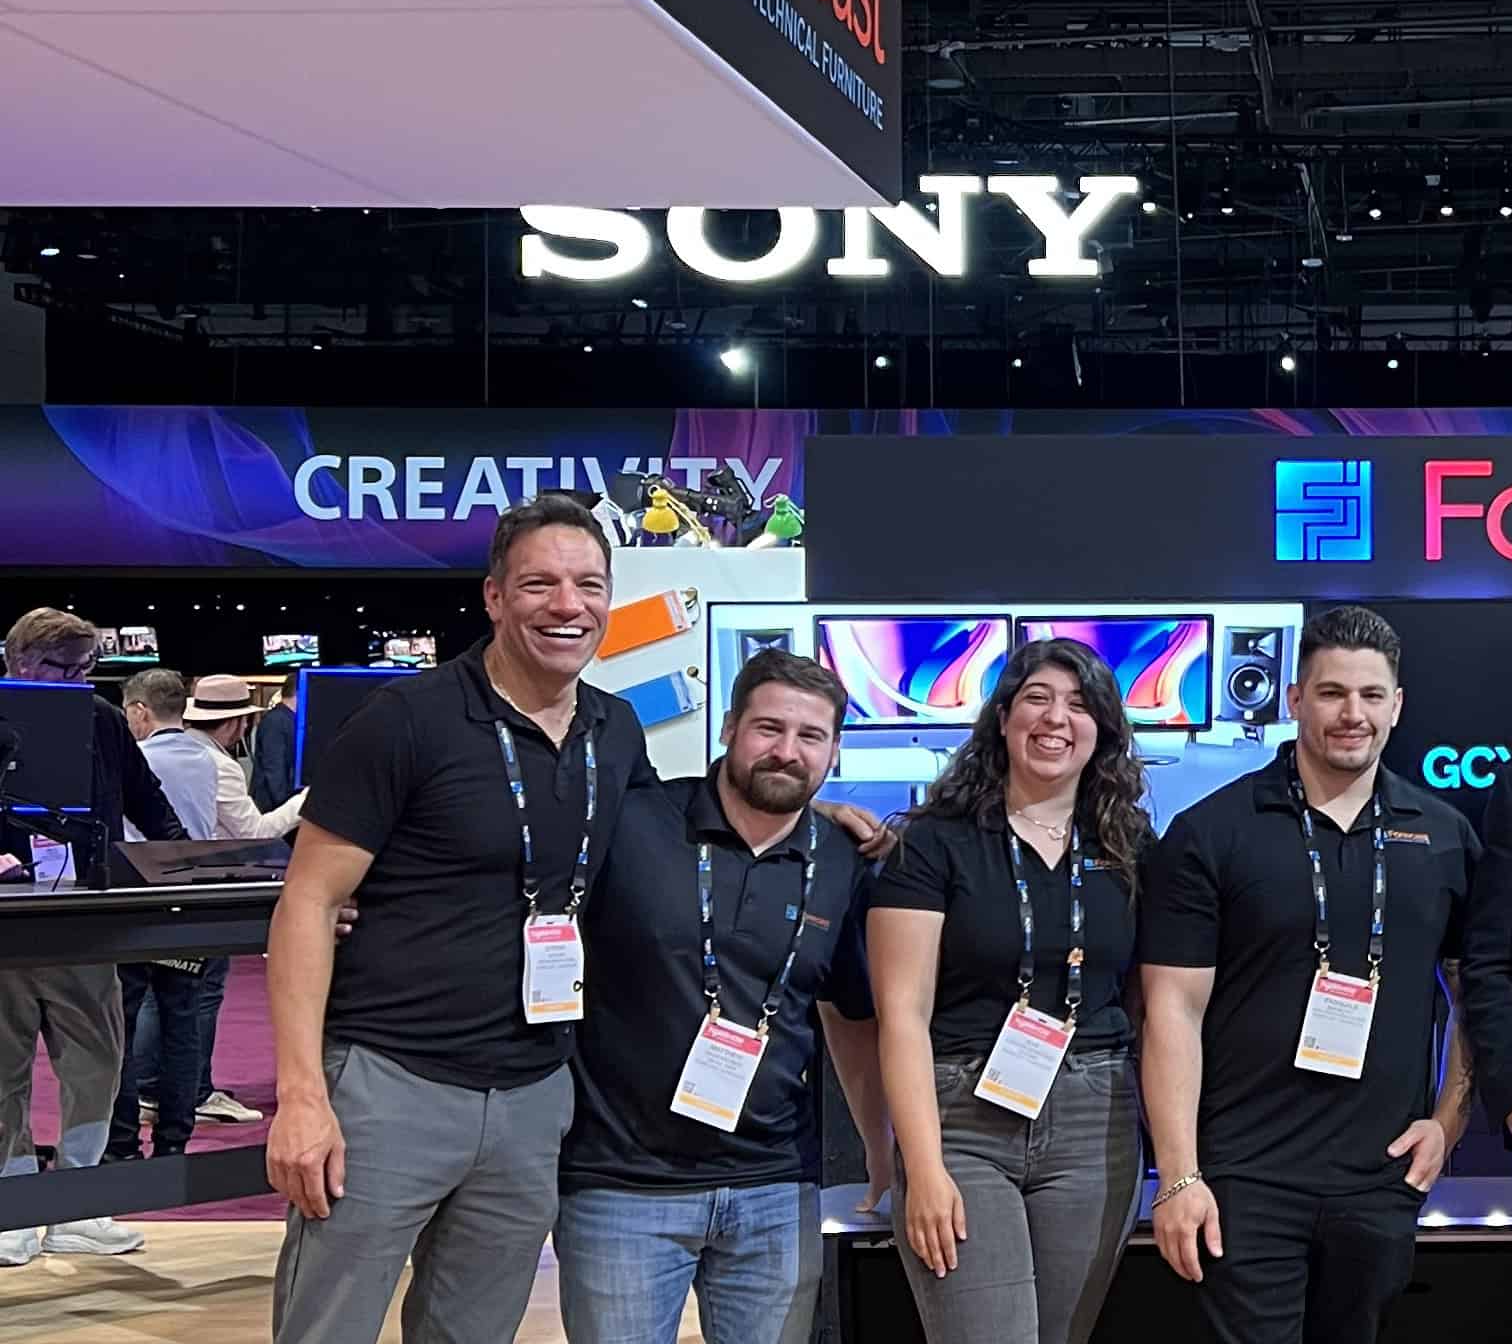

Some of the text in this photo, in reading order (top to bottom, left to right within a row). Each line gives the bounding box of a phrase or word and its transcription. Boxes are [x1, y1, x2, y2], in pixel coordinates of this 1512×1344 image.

[821, 42, 884, 130] FURNITURE
[521, 175, 1139, 281] SONY
[294, 454, 783, 520] CREATITY
